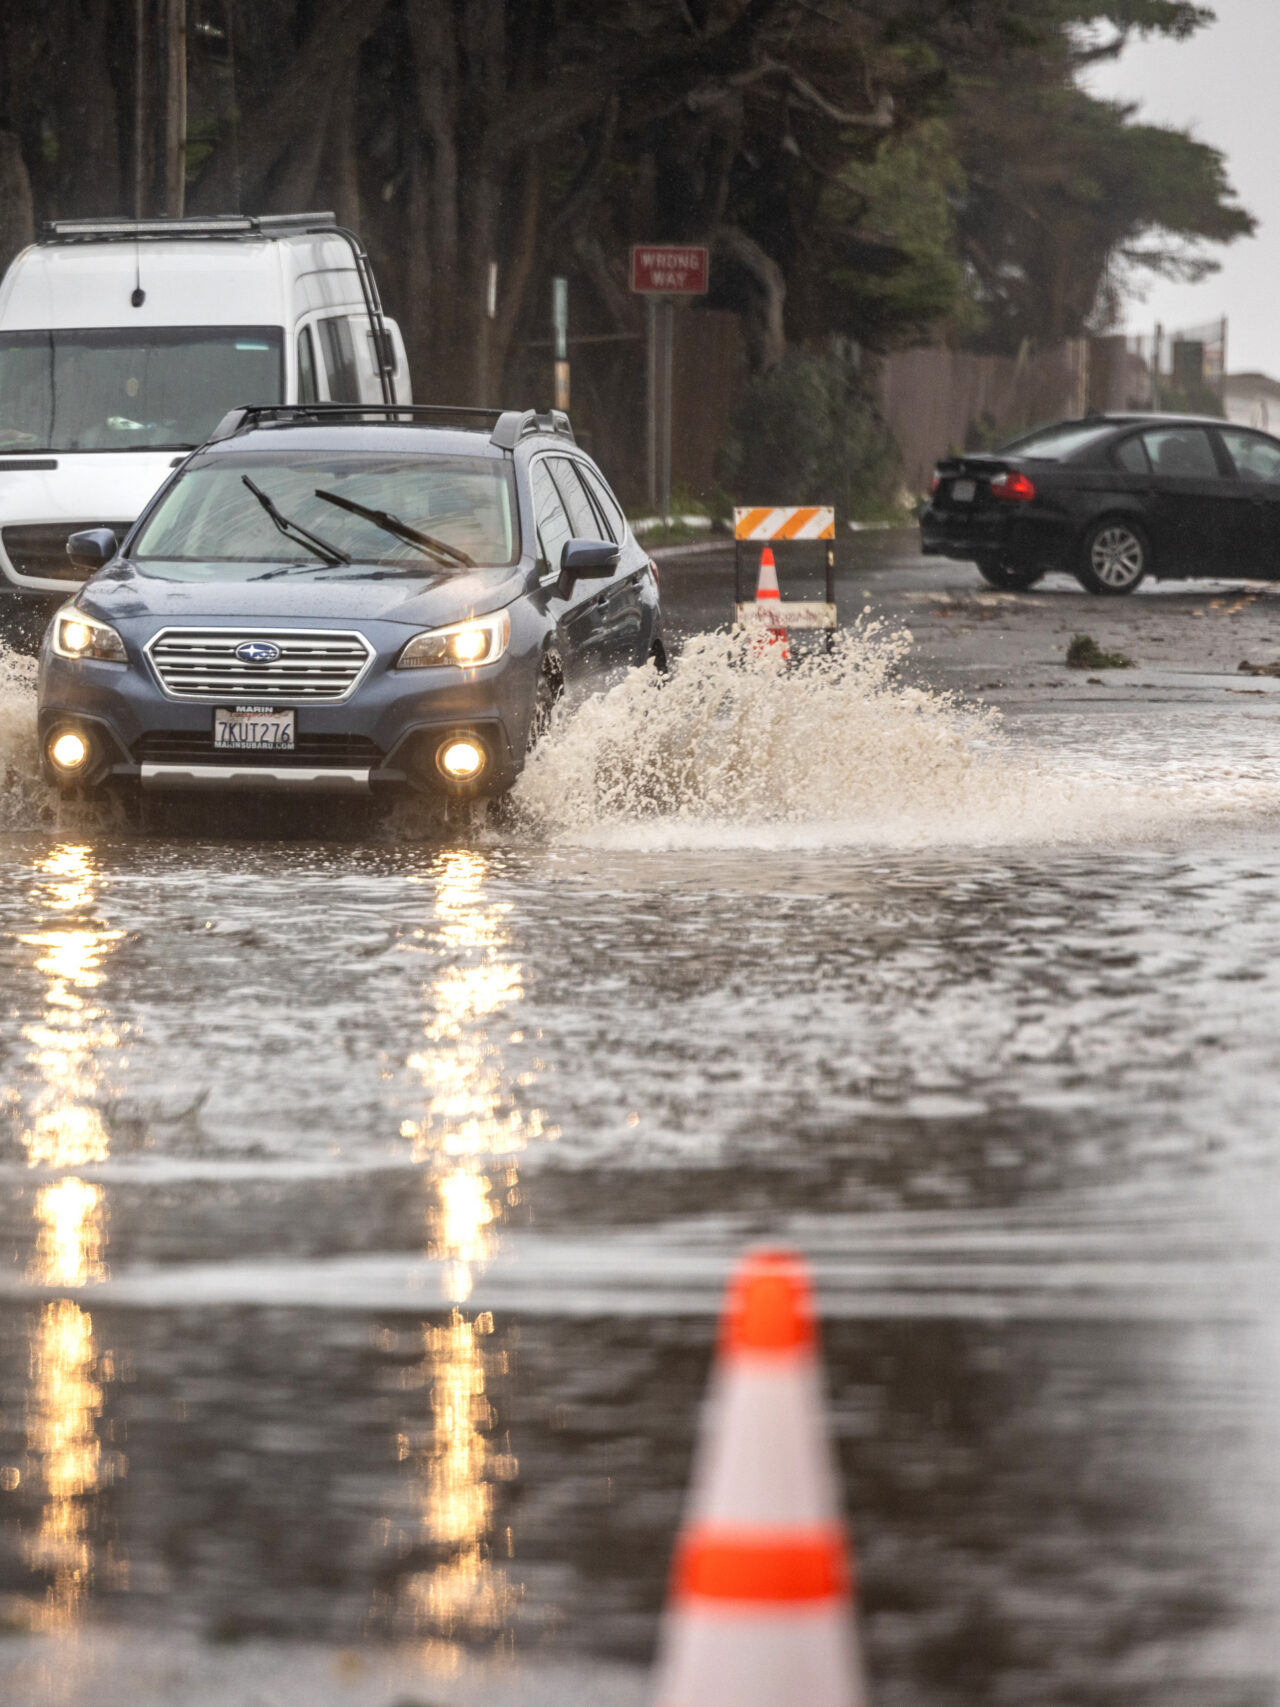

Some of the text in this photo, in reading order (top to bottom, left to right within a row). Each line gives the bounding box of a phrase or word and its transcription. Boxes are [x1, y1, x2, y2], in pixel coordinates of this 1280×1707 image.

[641, 253, 699, 270] WRONG
[651, 271, 688, 287] WAY
[219, 722, 291, 743] 7KUT276
